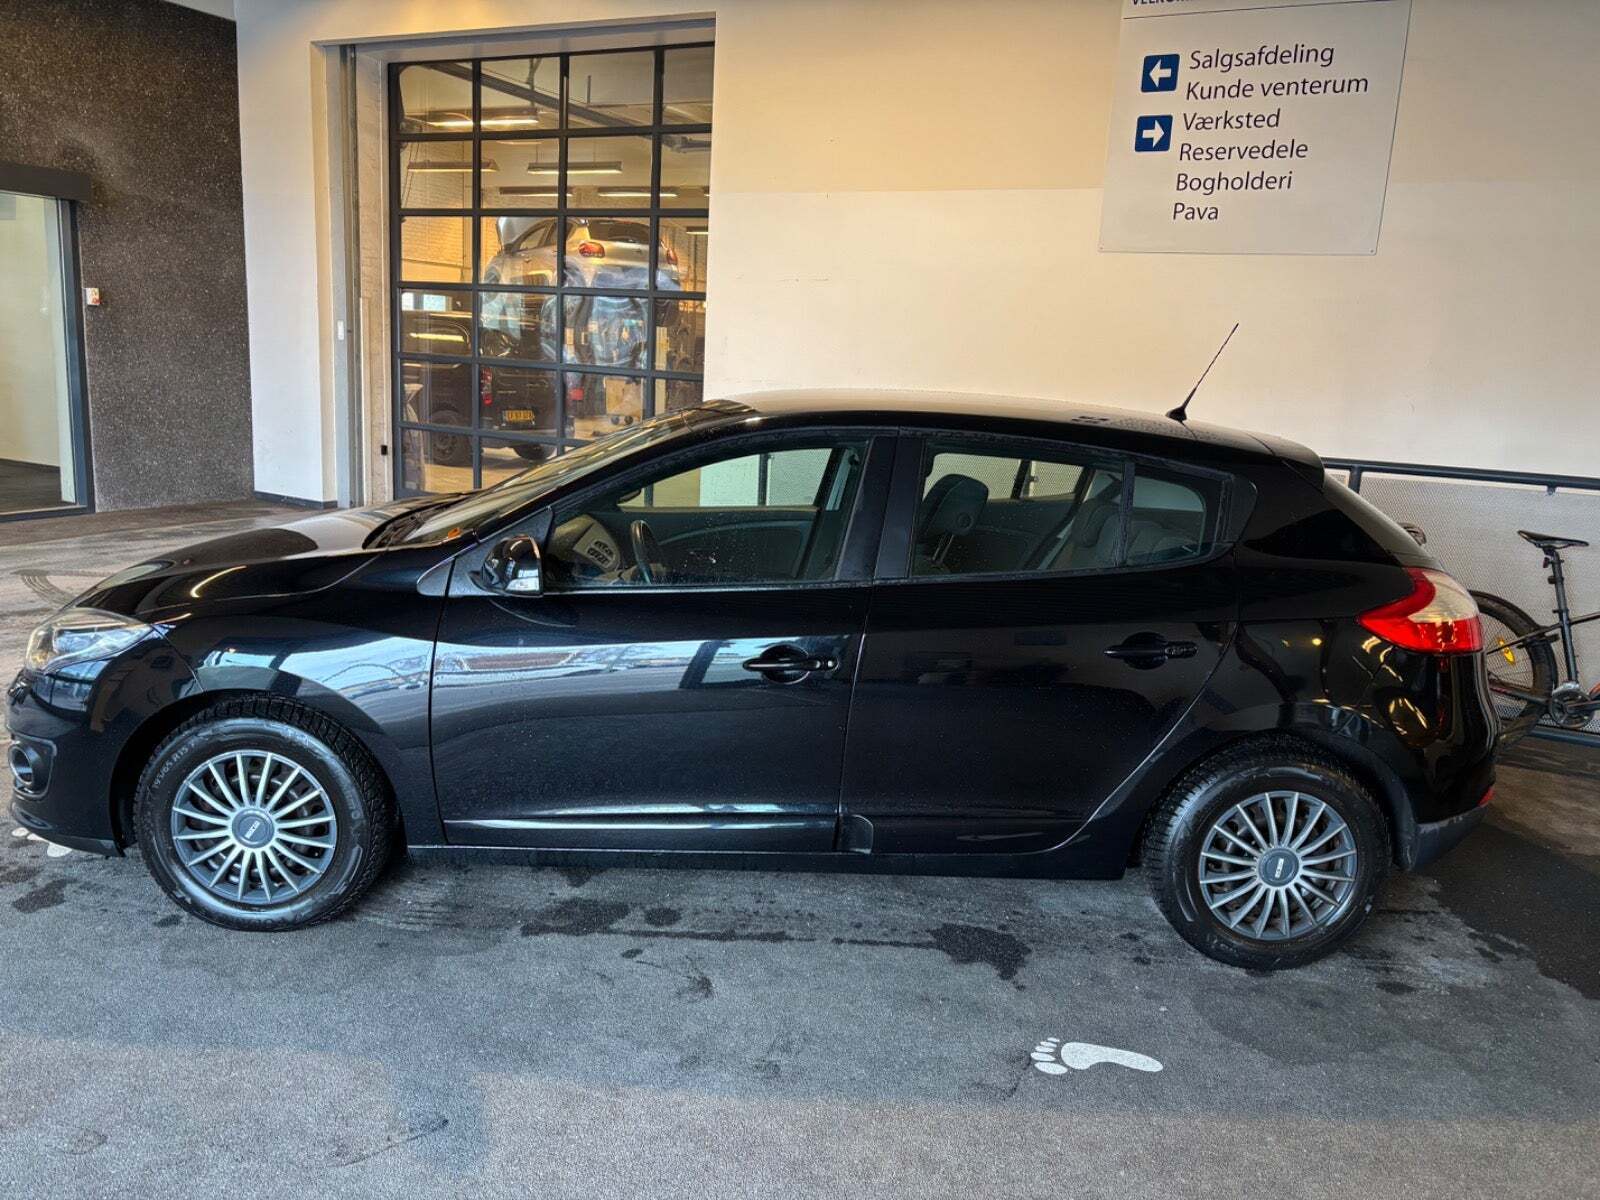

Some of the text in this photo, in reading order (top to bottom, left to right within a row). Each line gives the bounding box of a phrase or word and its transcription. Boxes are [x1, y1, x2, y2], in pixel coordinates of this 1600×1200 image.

[1189, 43, 1334, 73] Salgsafdeling
[1185, 77, 1369, 101] Kunde venterum
[1182, 107, 1281, 131] Værksted
[1179, 138, 1309, 161] Reservedele
[1175, 170, 1293, 196] Bogholderi
[1172, 202, 1219, 221] Pava
